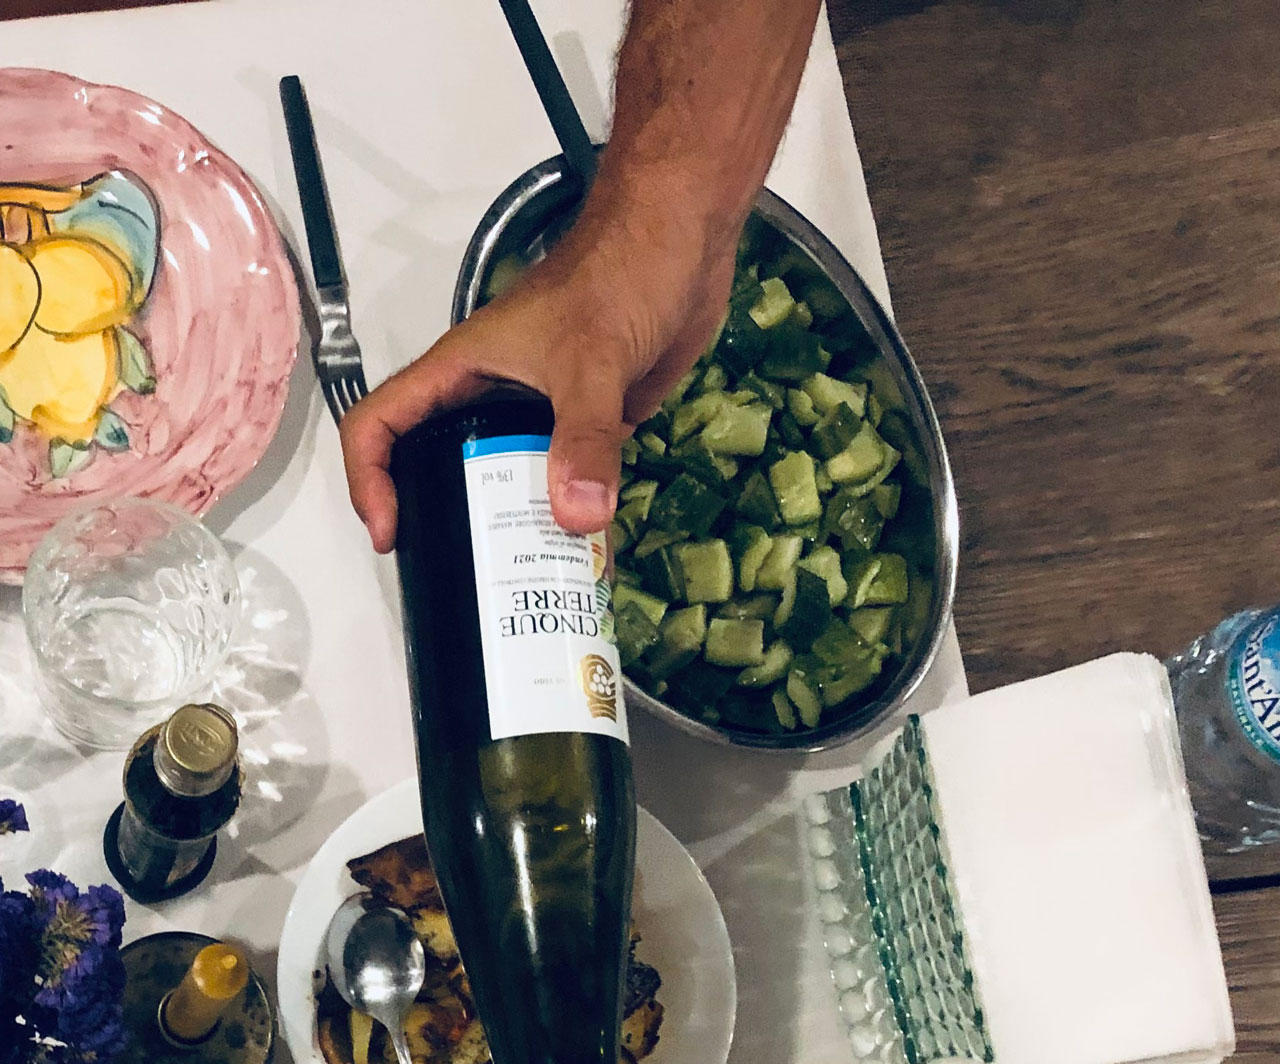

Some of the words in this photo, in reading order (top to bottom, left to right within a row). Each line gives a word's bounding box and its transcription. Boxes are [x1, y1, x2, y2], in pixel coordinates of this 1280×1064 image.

[480, 471, 495, 485] vol
[496, 468, 513, 483] 13%
[512, 555, 537, 564] 2021
[540, 554, 589, 568] Vendemmia
[511, 589, 597, 615] TERRE
[499, 612, 599, 638] CINQUE
